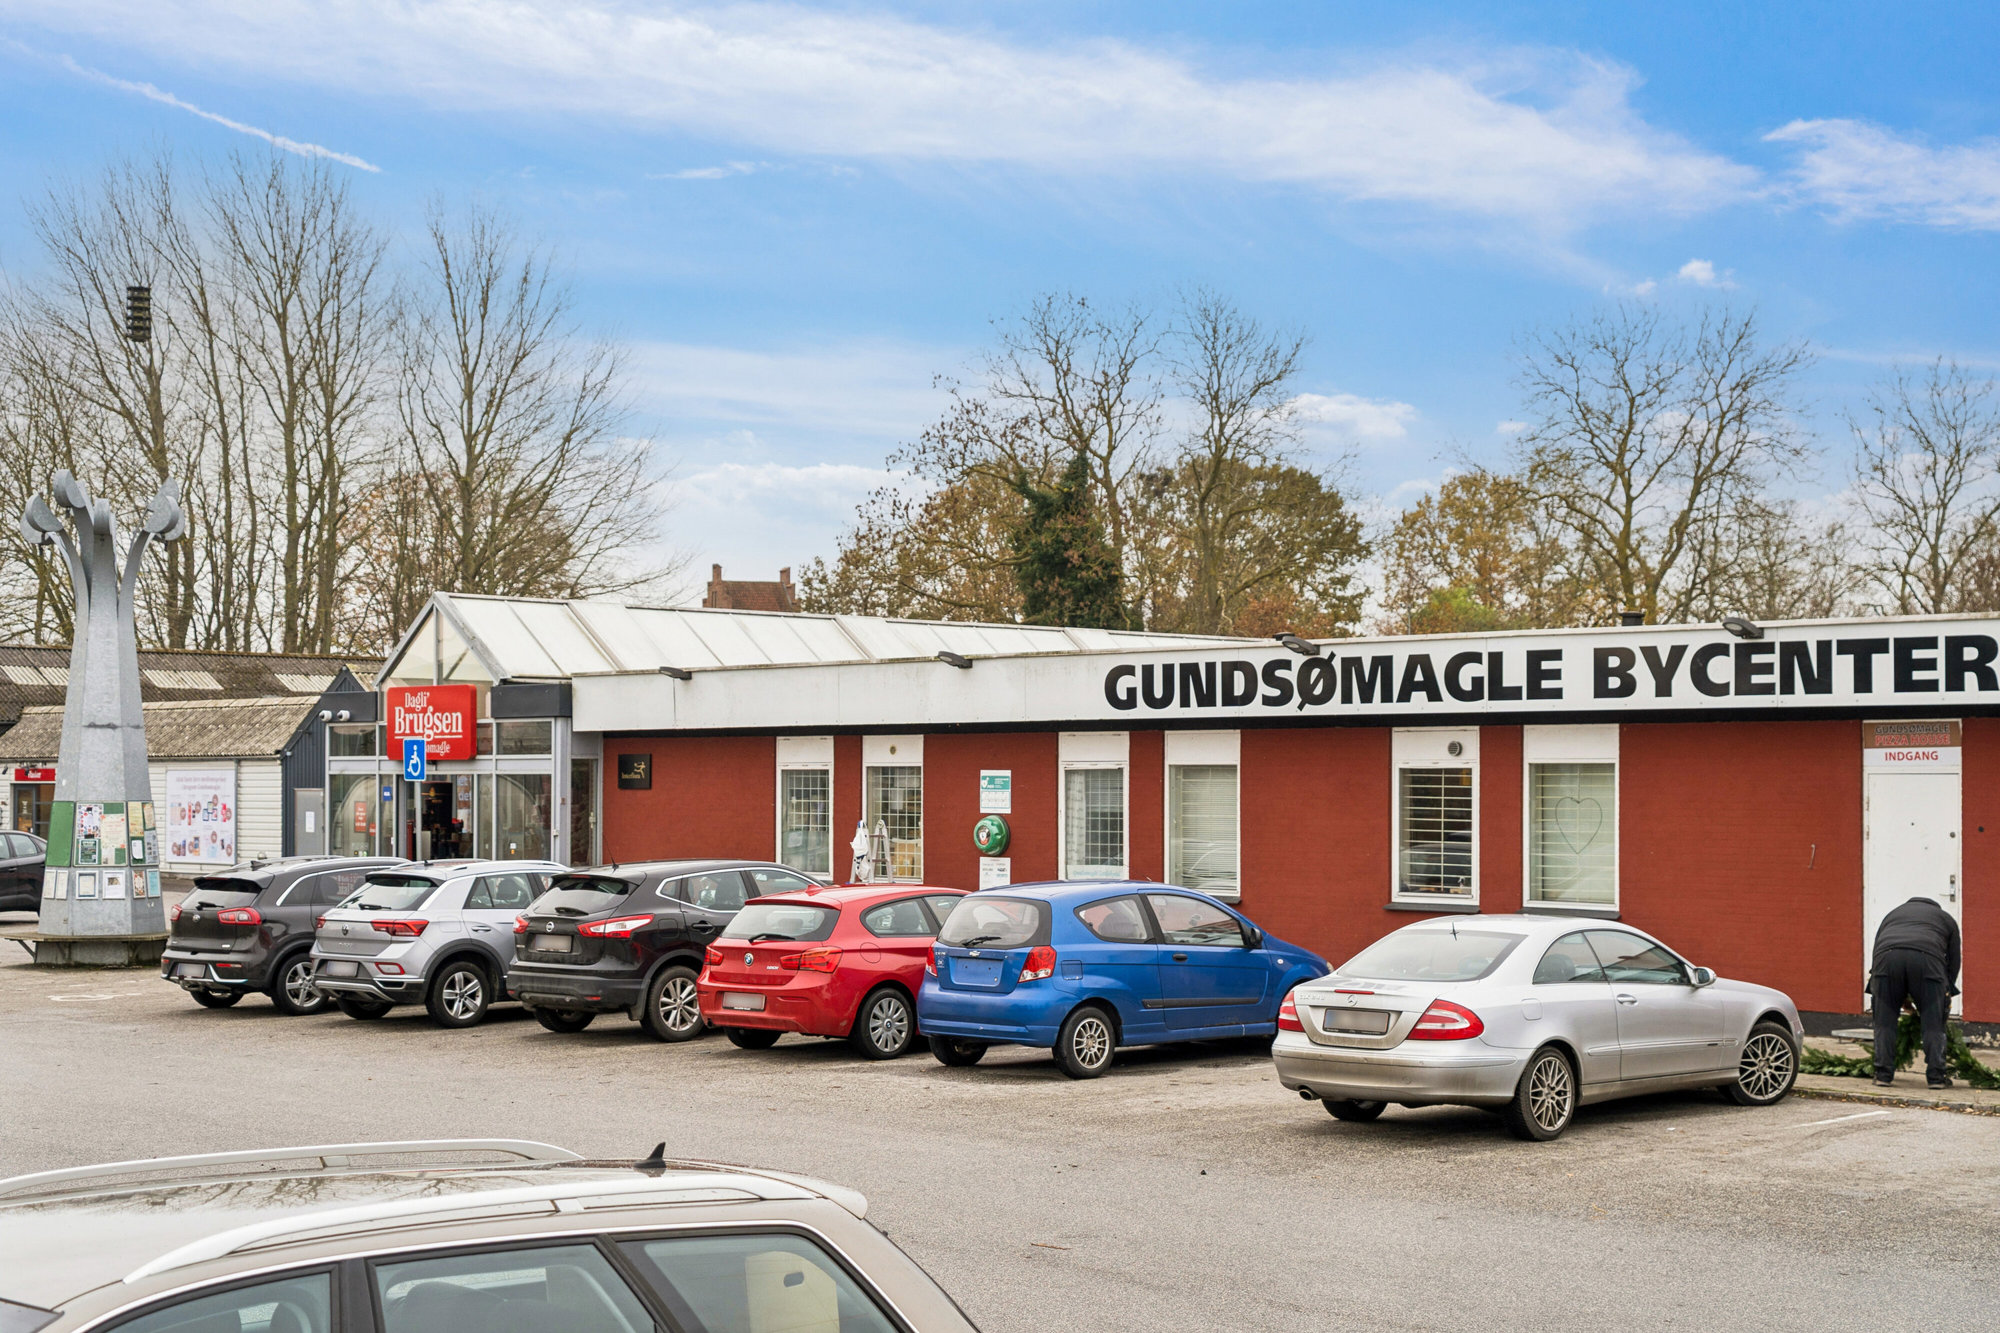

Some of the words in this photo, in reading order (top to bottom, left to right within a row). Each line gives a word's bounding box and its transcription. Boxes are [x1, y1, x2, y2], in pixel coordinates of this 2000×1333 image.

[1105, 652, 1562, 711] GUNDSØMAGLE
[1594, 635, 1999, 699] BYCENTER
[394, 706, 463, 741] Brugsen
[1875, 723, 1950, 735] GUNDSØMAGLE
[1875, 734, 1909, 746] PIZZA
[1910, 733, 1951, 745] HOUSE
[1885, 751, 1939, 761] INDGANG
